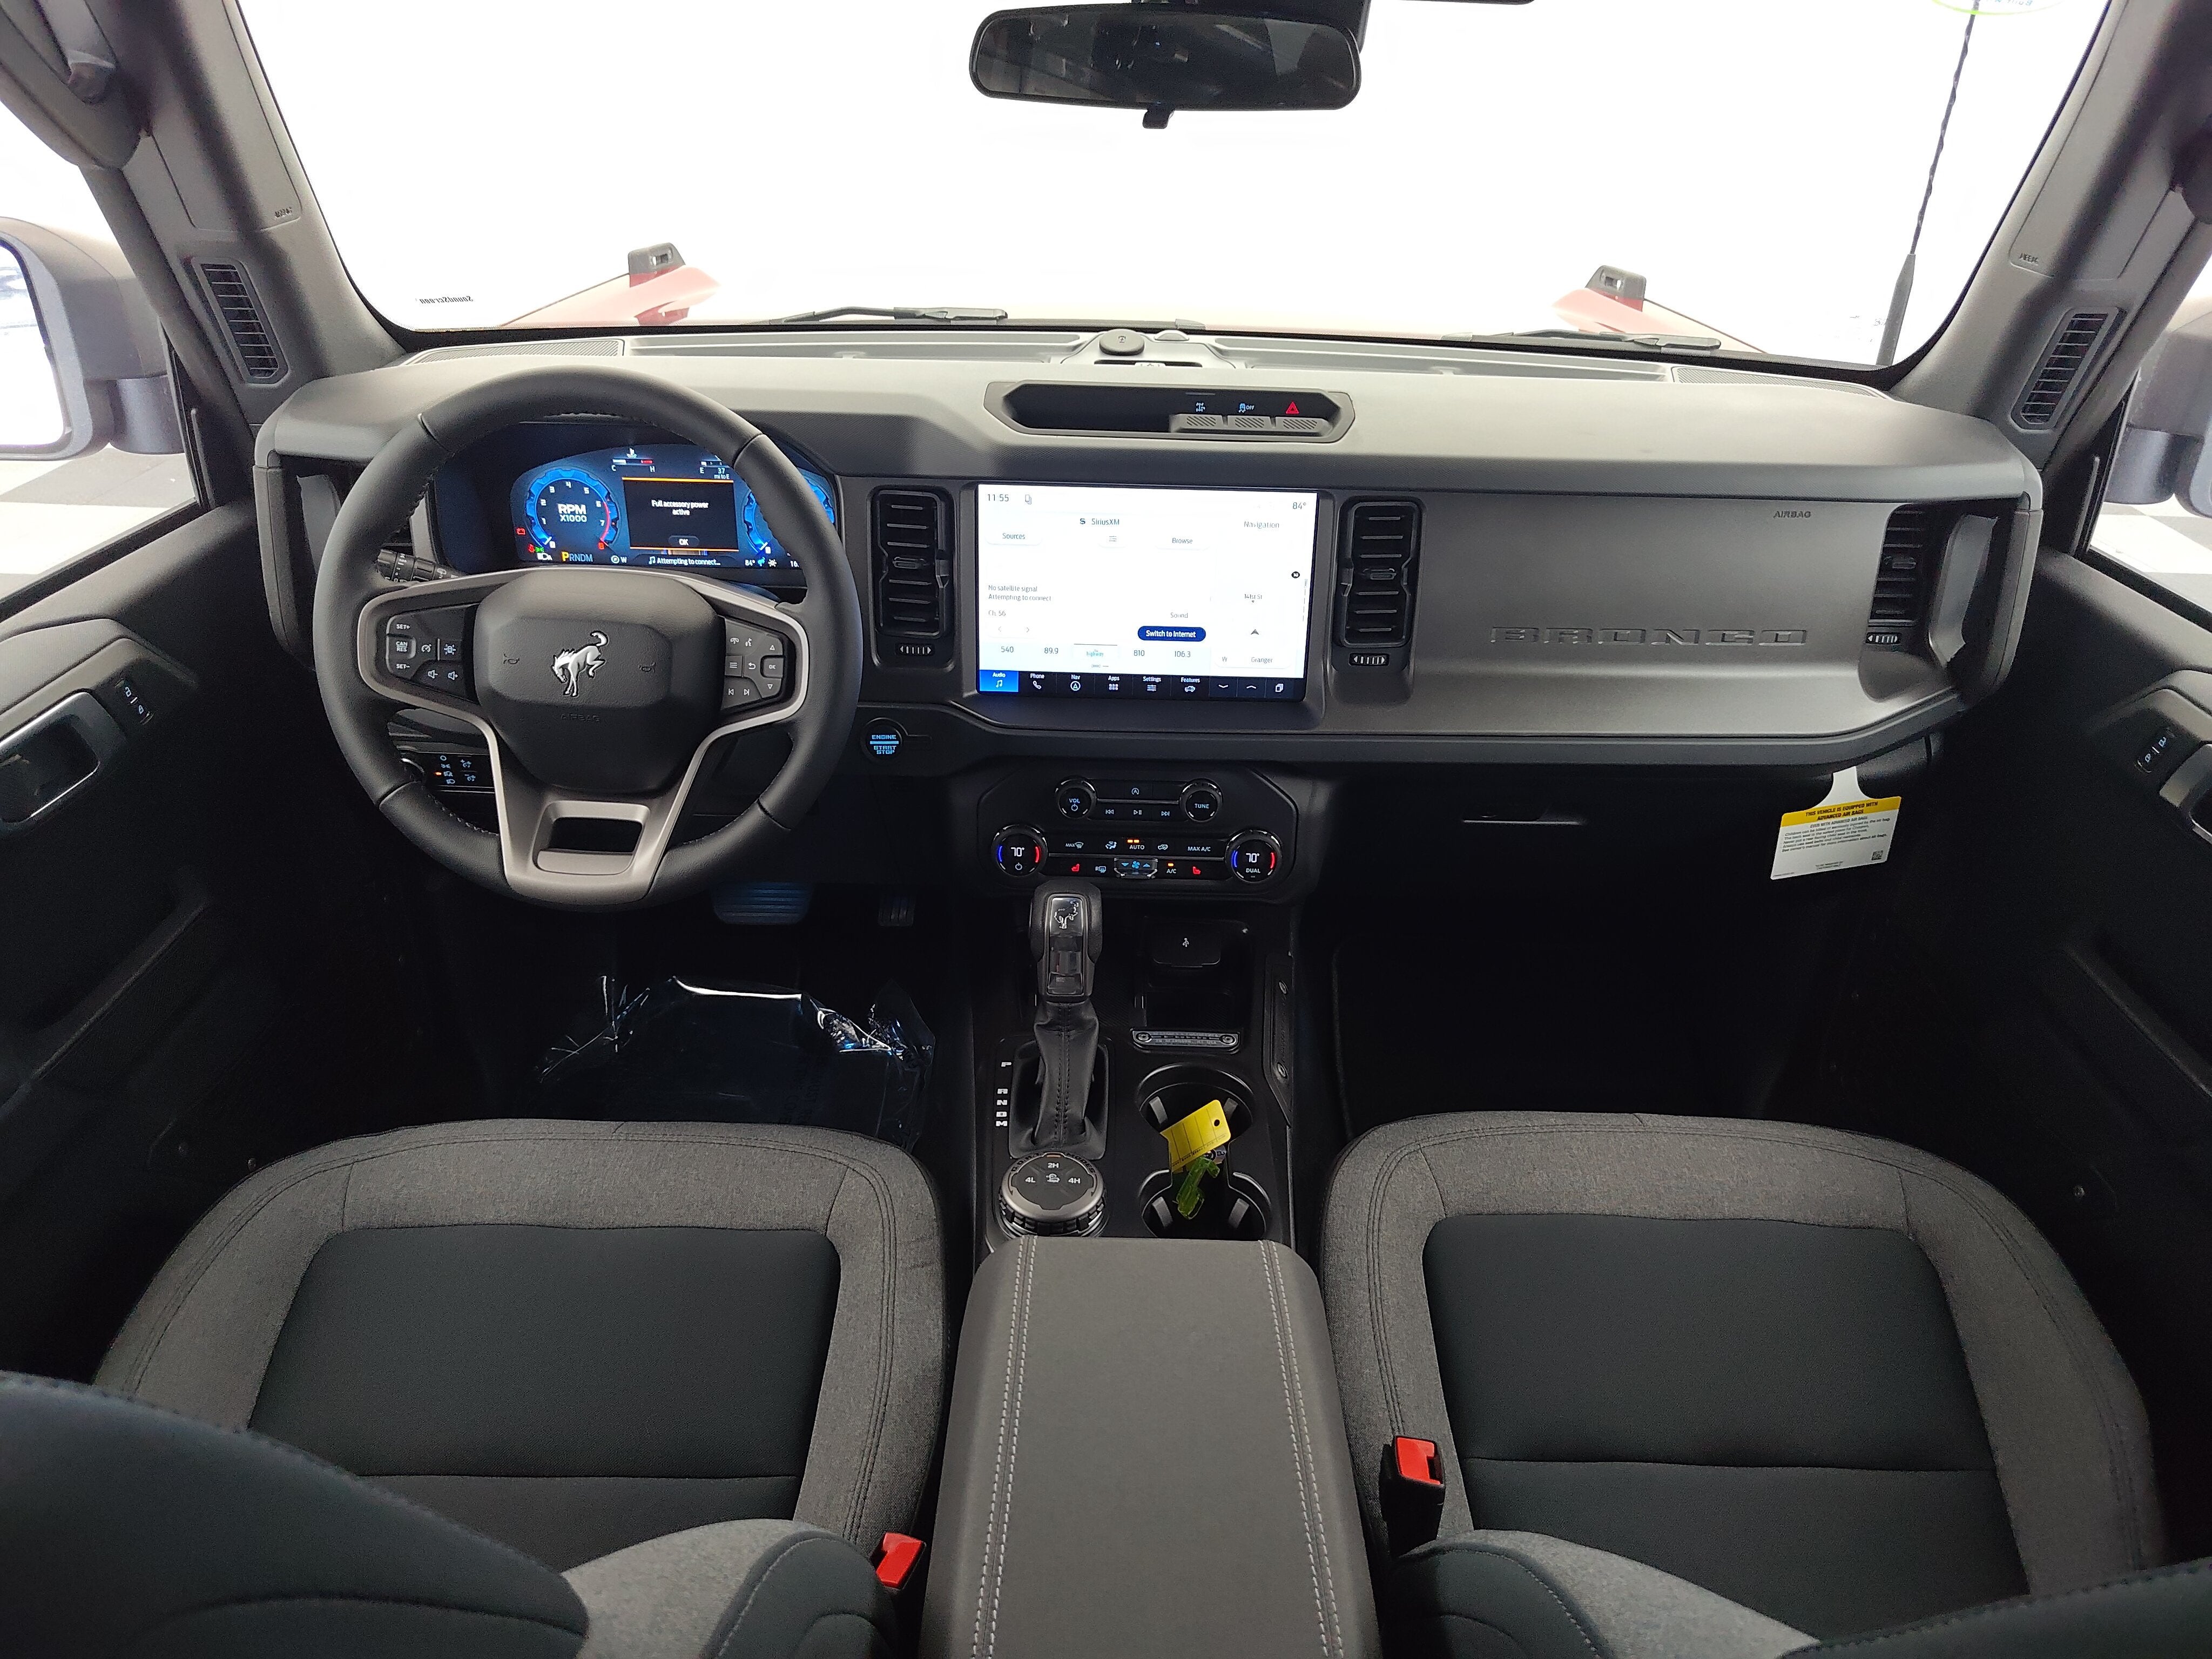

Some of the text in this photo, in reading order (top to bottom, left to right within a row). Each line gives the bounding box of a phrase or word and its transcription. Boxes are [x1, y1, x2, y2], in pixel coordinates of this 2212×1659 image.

[987, 494, 1009, 502] 1155
[557, 503, 587, 515] RPM
[559, 515, 588, 523] X1000
[1244, 521, 1279, 529] Navigation
[562, 551, 593, 562] PRNDM
[657, 557, 689, 565] Attempting
[988, 594, 1021, 602] Attempting
[1490, 626, 1808, 646] BRONCO
[1010, 847, 1025, 857] 70°
[1245, 853, 1260, 863] 70°
